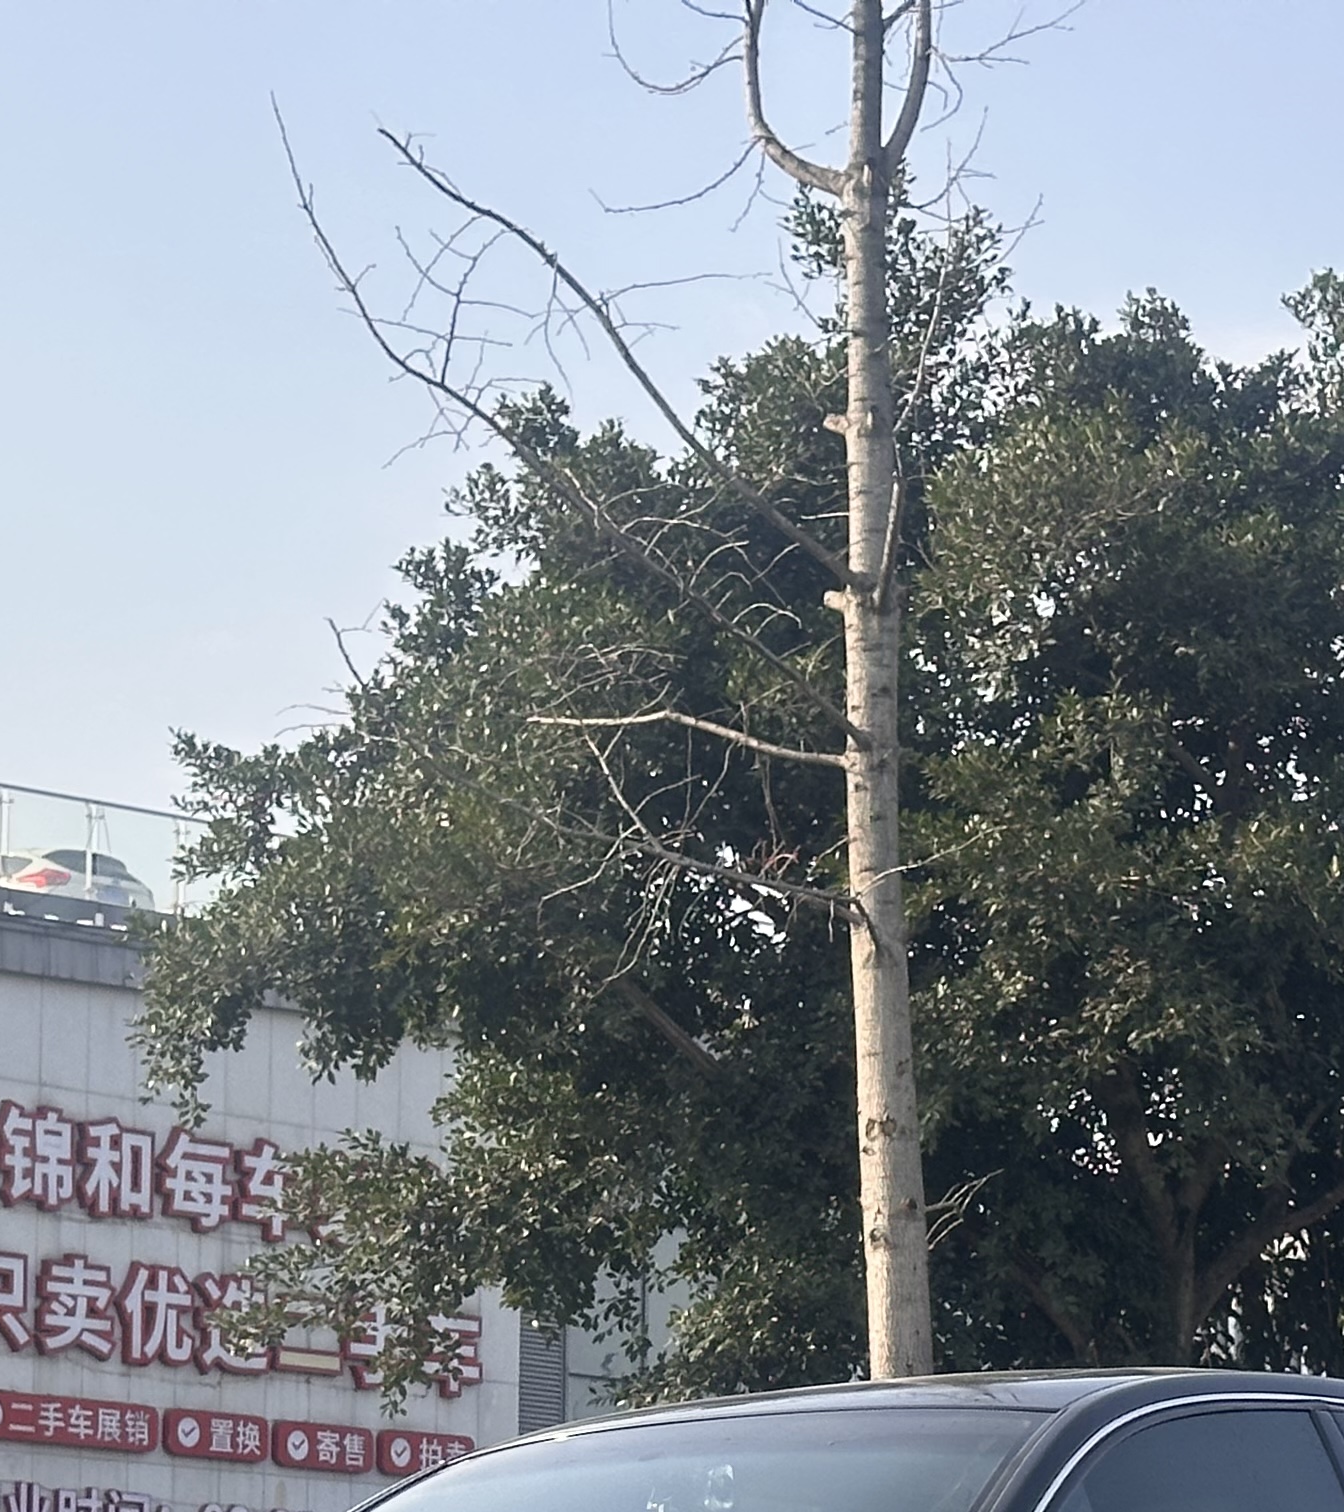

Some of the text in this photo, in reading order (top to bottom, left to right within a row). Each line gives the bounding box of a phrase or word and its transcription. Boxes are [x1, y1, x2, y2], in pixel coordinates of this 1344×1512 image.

[8, 1401, 150, 1447] 二手车展销
[208, 1417, 262, 1456] 置换
[315, 1429, 366, 1467] 寄售
